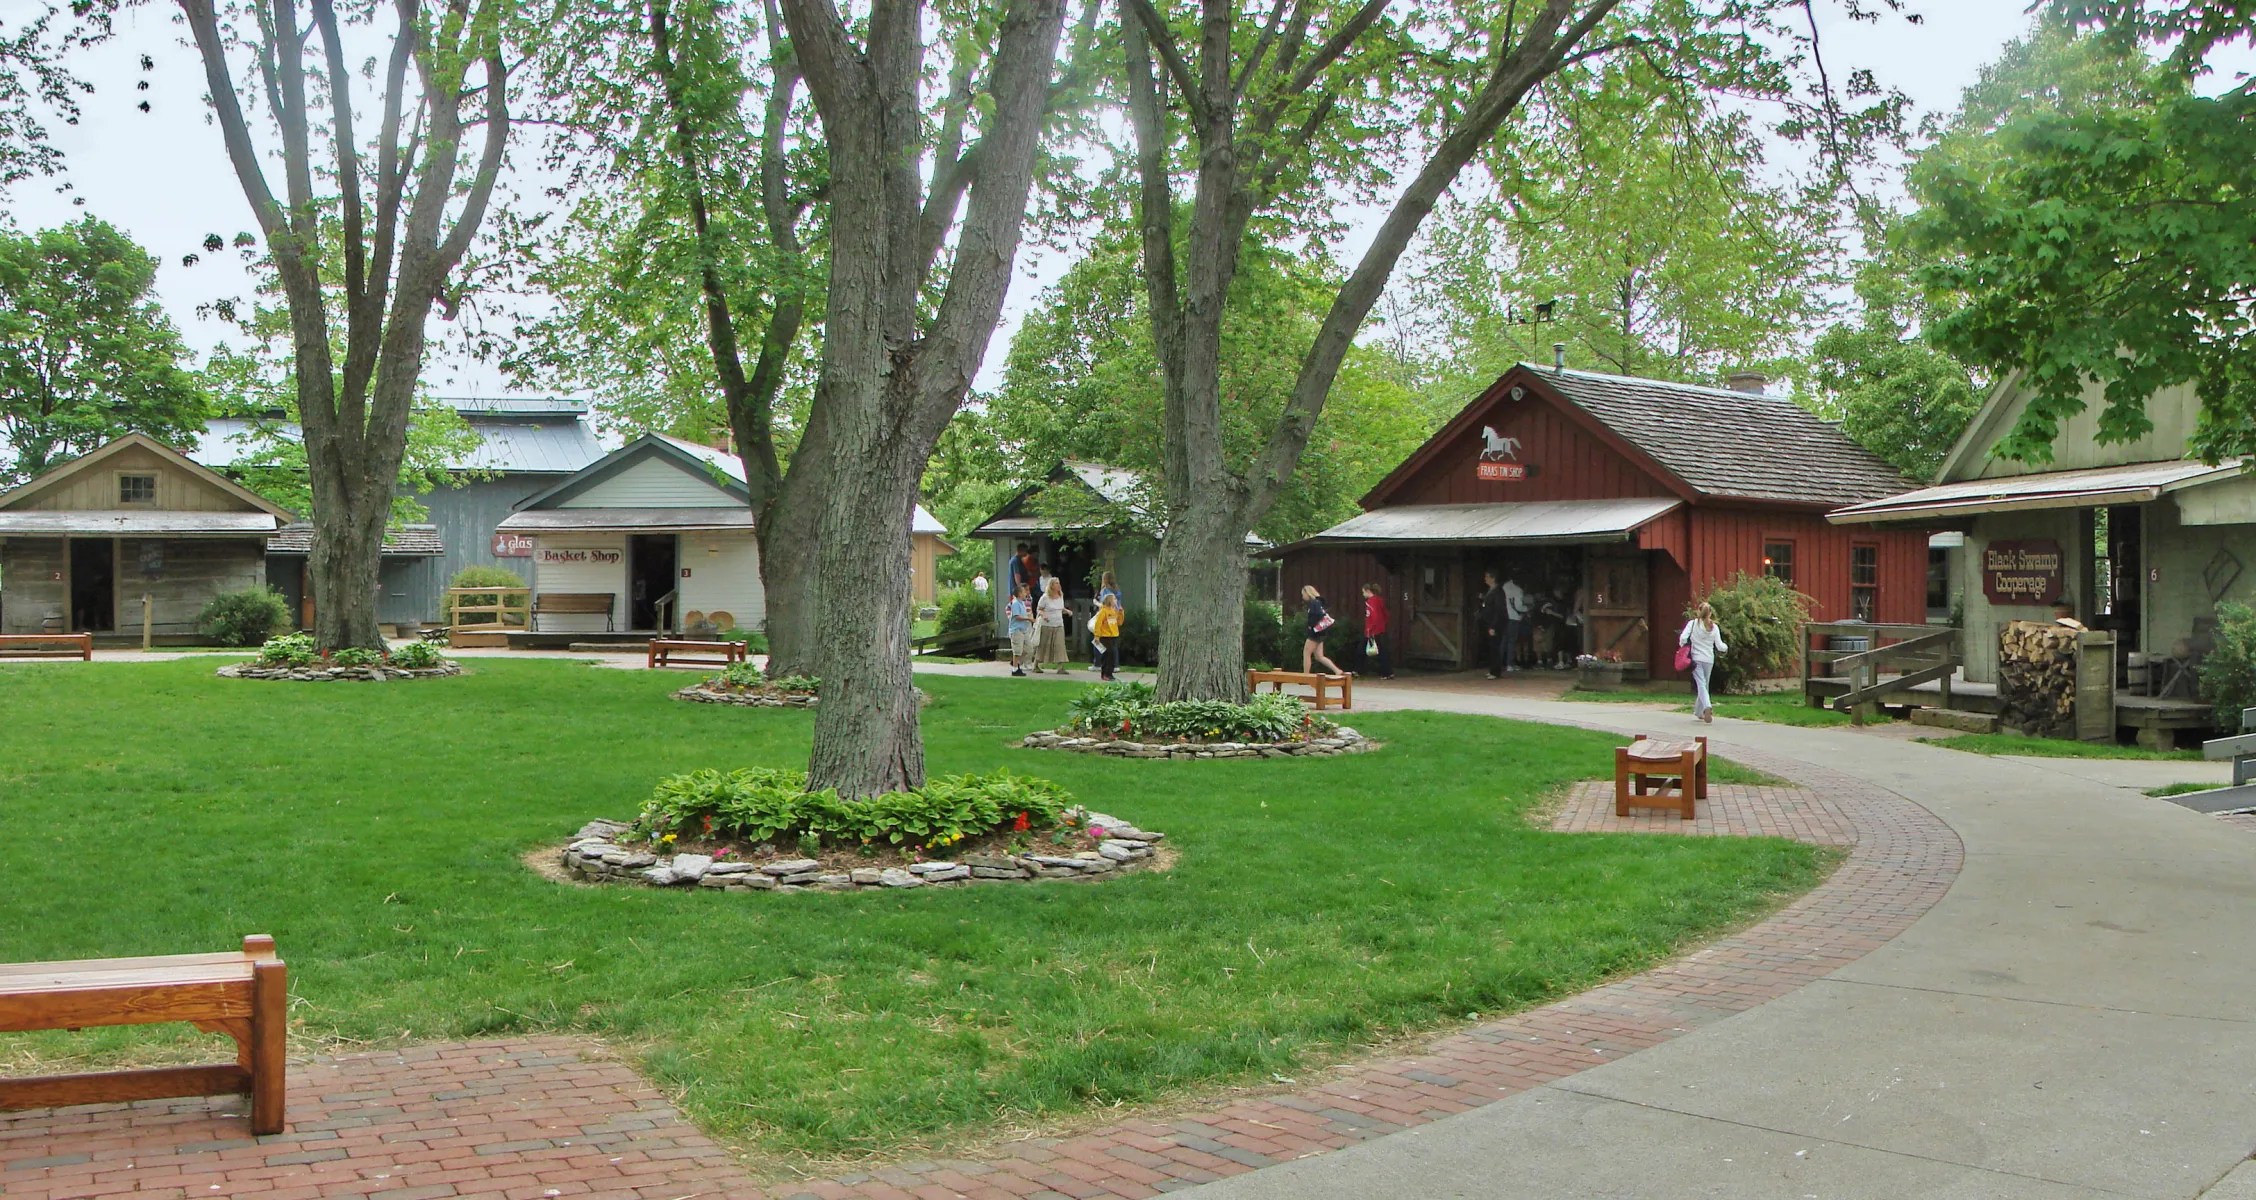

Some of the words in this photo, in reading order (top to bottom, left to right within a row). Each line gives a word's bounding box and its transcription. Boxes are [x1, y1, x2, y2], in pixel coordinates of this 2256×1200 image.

[1499, 466, 1508, 477] TIN
[1508, 467, 1523, 478] SHOP
[544, 550, 587, 564] Basket
[589, 550, 620, 564] Shop
[1987, 549, 2017, 571] Black
[2019, 549, 2058, 577] Swamp
[55, 572, 61, 580] 2
[2150, 568, 2157, 581] 6
[1995, 571, 2047, 600] Cooperage
[1597, 594, 1603, 603] 5
